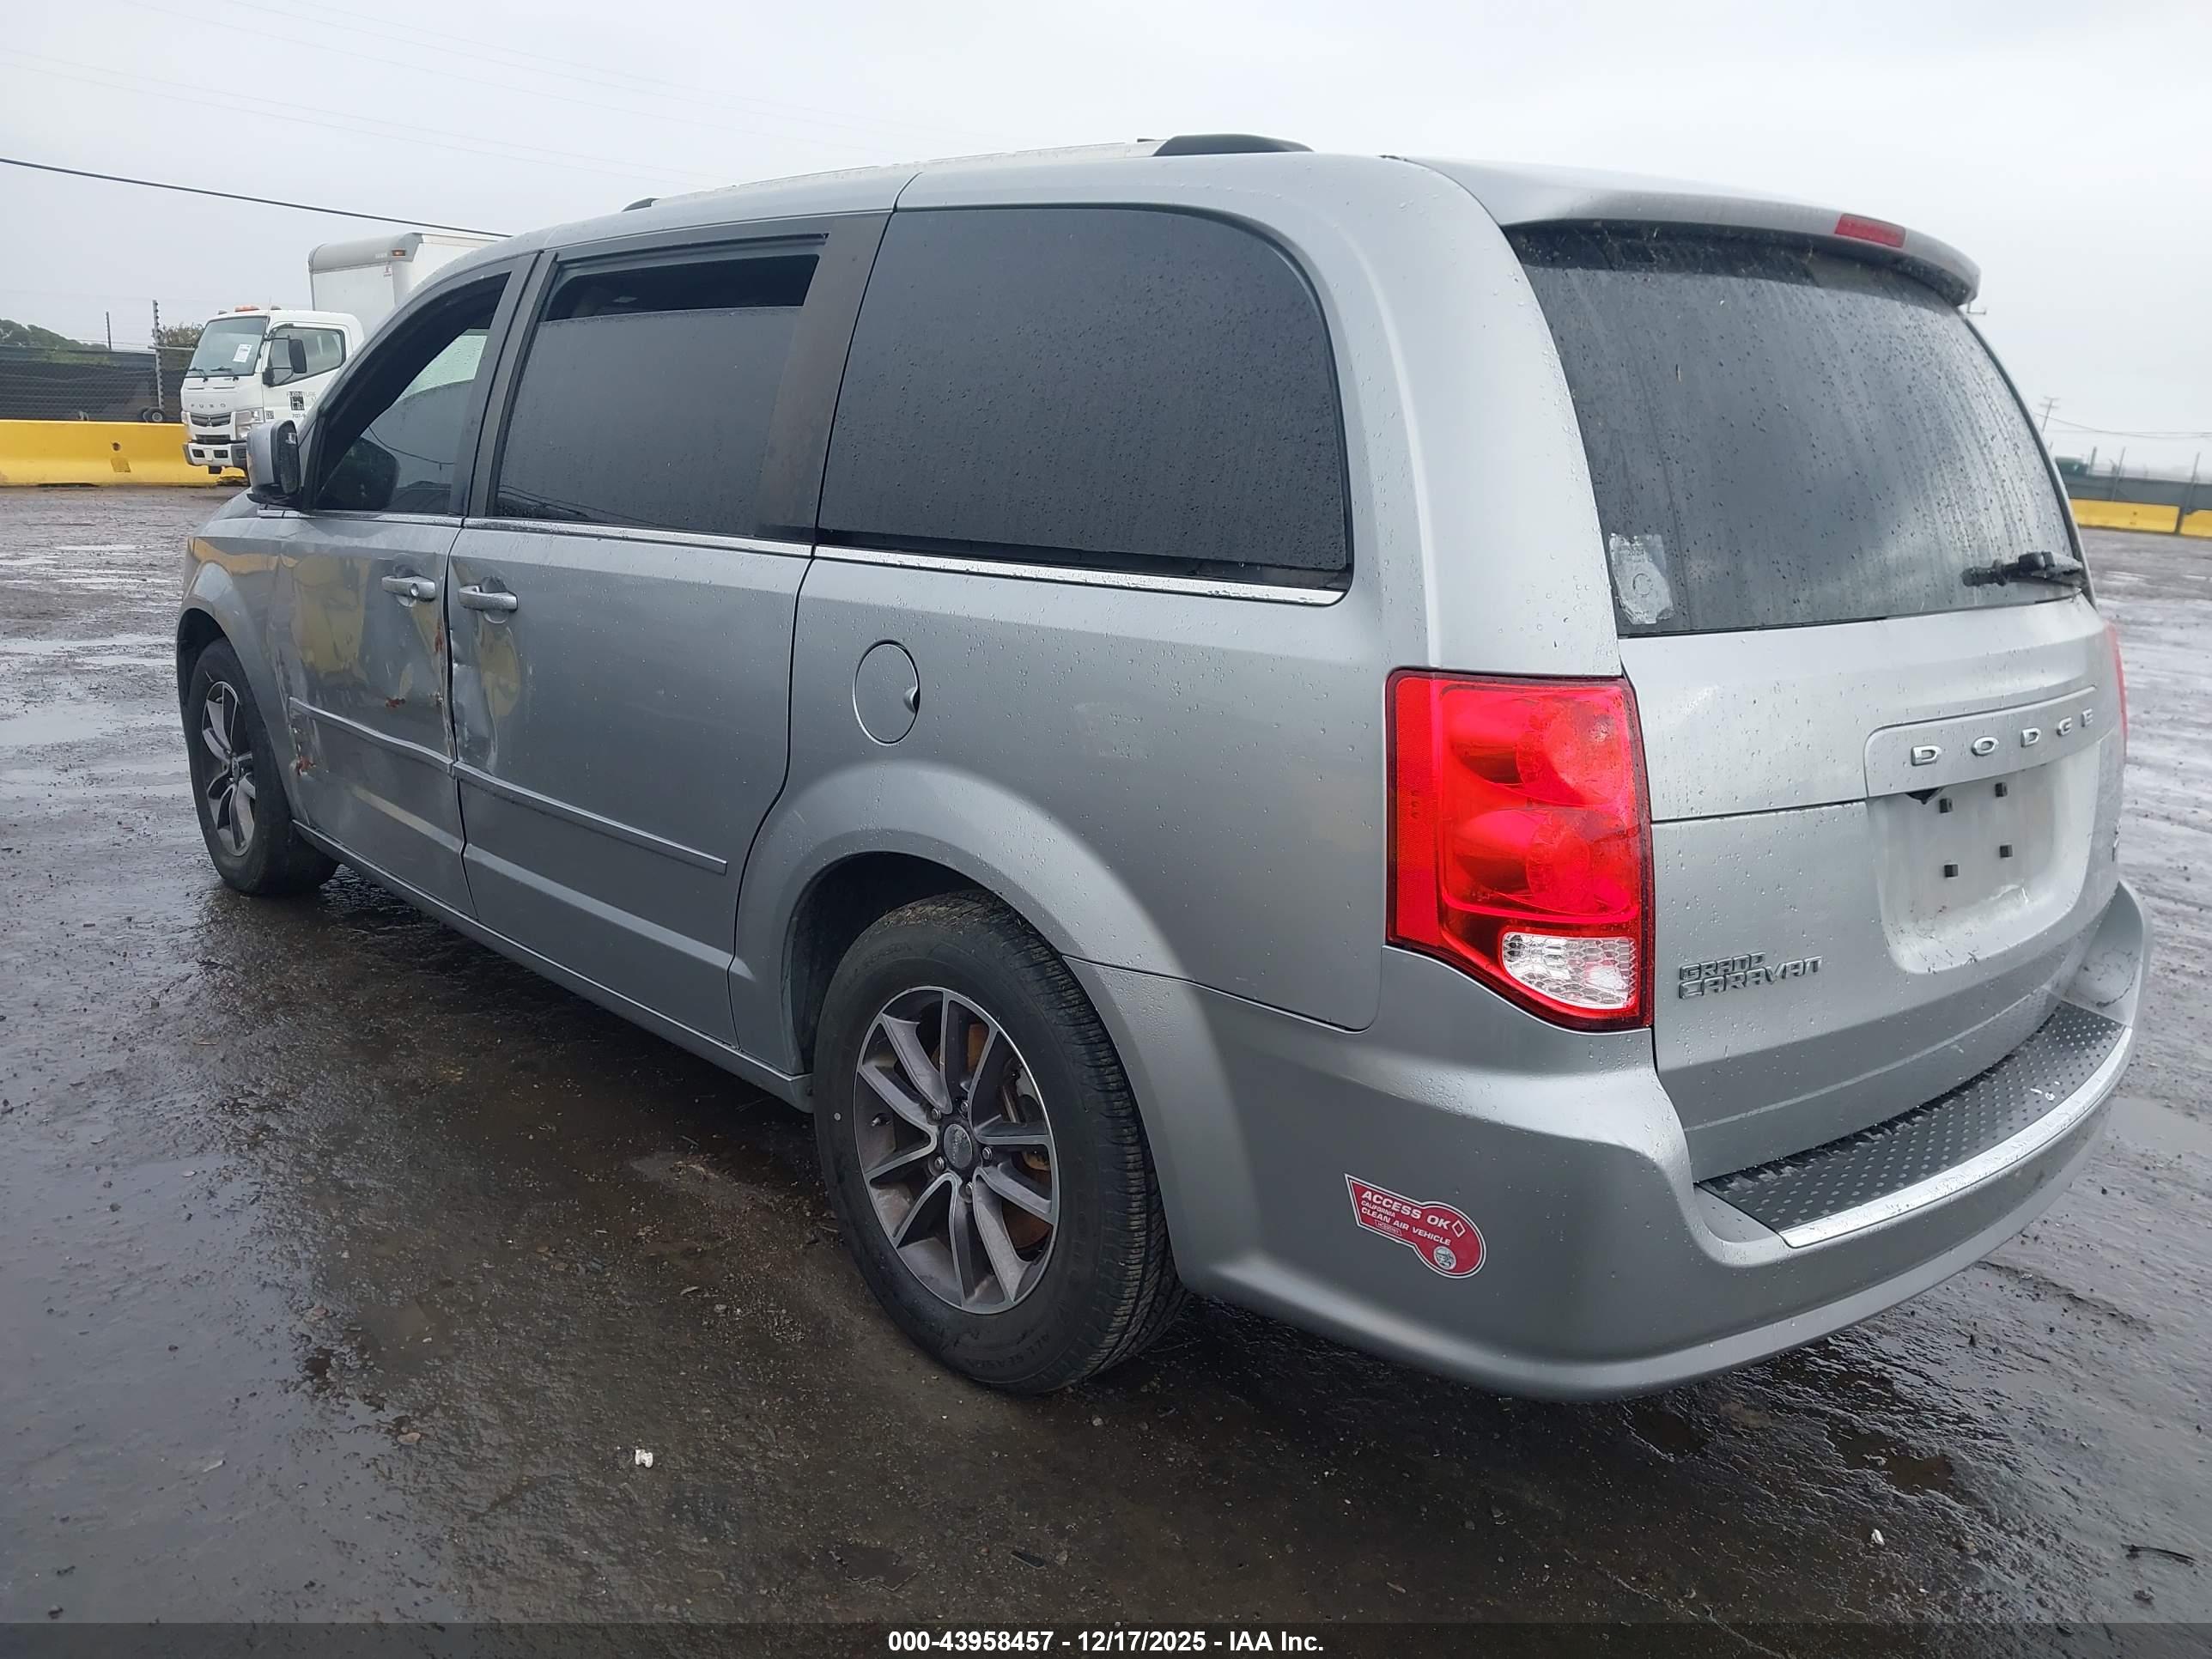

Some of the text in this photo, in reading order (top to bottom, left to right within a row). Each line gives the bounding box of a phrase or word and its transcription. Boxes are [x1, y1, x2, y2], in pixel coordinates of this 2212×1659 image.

[1911, 708, 2094, 766] DODGE
[1679, 956, 1822, 1000] CARAVAN
[1680, 951, 1766, 980] GRAND
[1361, 1200, 1395, 1218] CALIFORNIA
[1361, 1190, 1422, 1219] ACCESS
[1426, 1214, 1451, 1231] OK
[1361, 1206, 1391, 1224] CLEAN
[1393, 1219, 1410, 1231] AIR
[1412, 1226, 1451, 1246] VEHICLE
